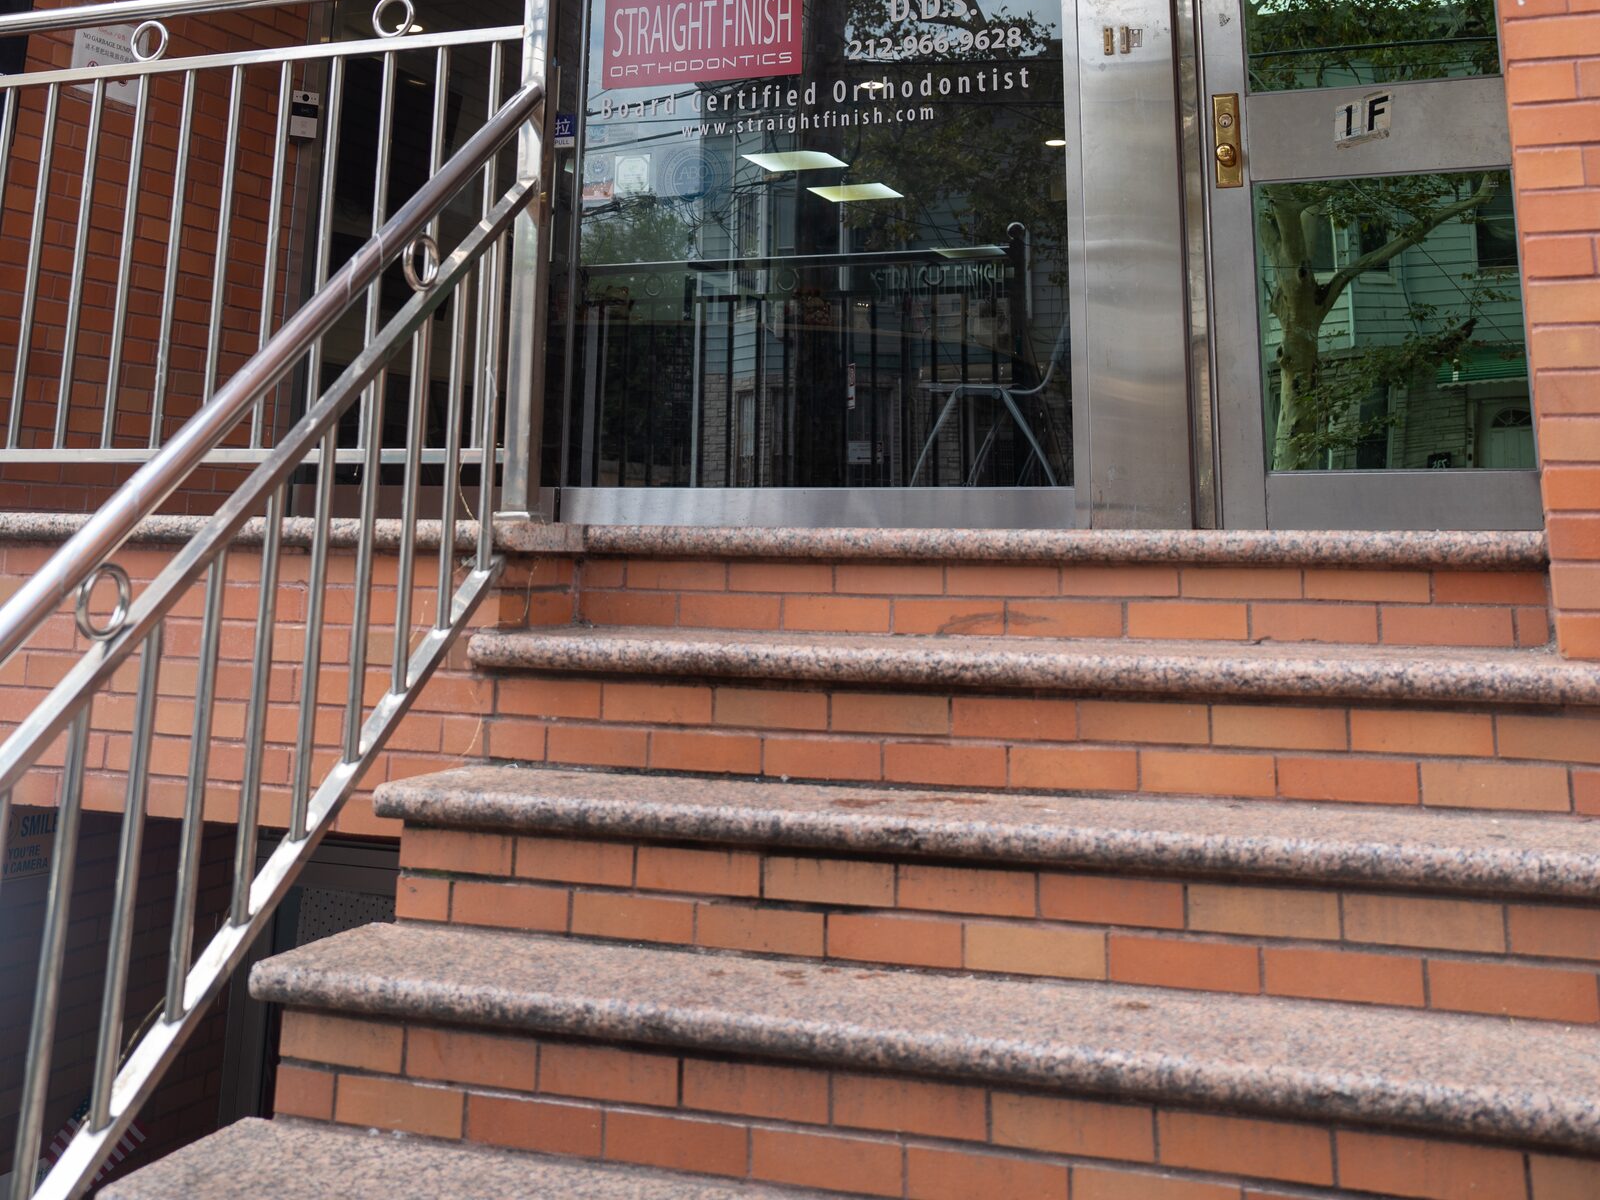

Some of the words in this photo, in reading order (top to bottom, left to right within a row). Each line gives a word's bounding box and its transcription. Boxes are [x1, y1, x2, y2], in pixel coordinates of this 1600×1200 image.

[612, 0, 718, 58] STRAIGHT
[848, 27, 1023, 60] 212-966-9628
[610, 52, 793, 78] ORTHODONTICS
[602, 91, 676, 119] Board
[690, 81, 817, 113] Certified
[833, 67, 1029, 103] Orthodontist
[555, 118, 571, 136] 拉
[681, 107, 934, 138] www.straightfinish.com
[10, 857, 48, 874] CAMERA
